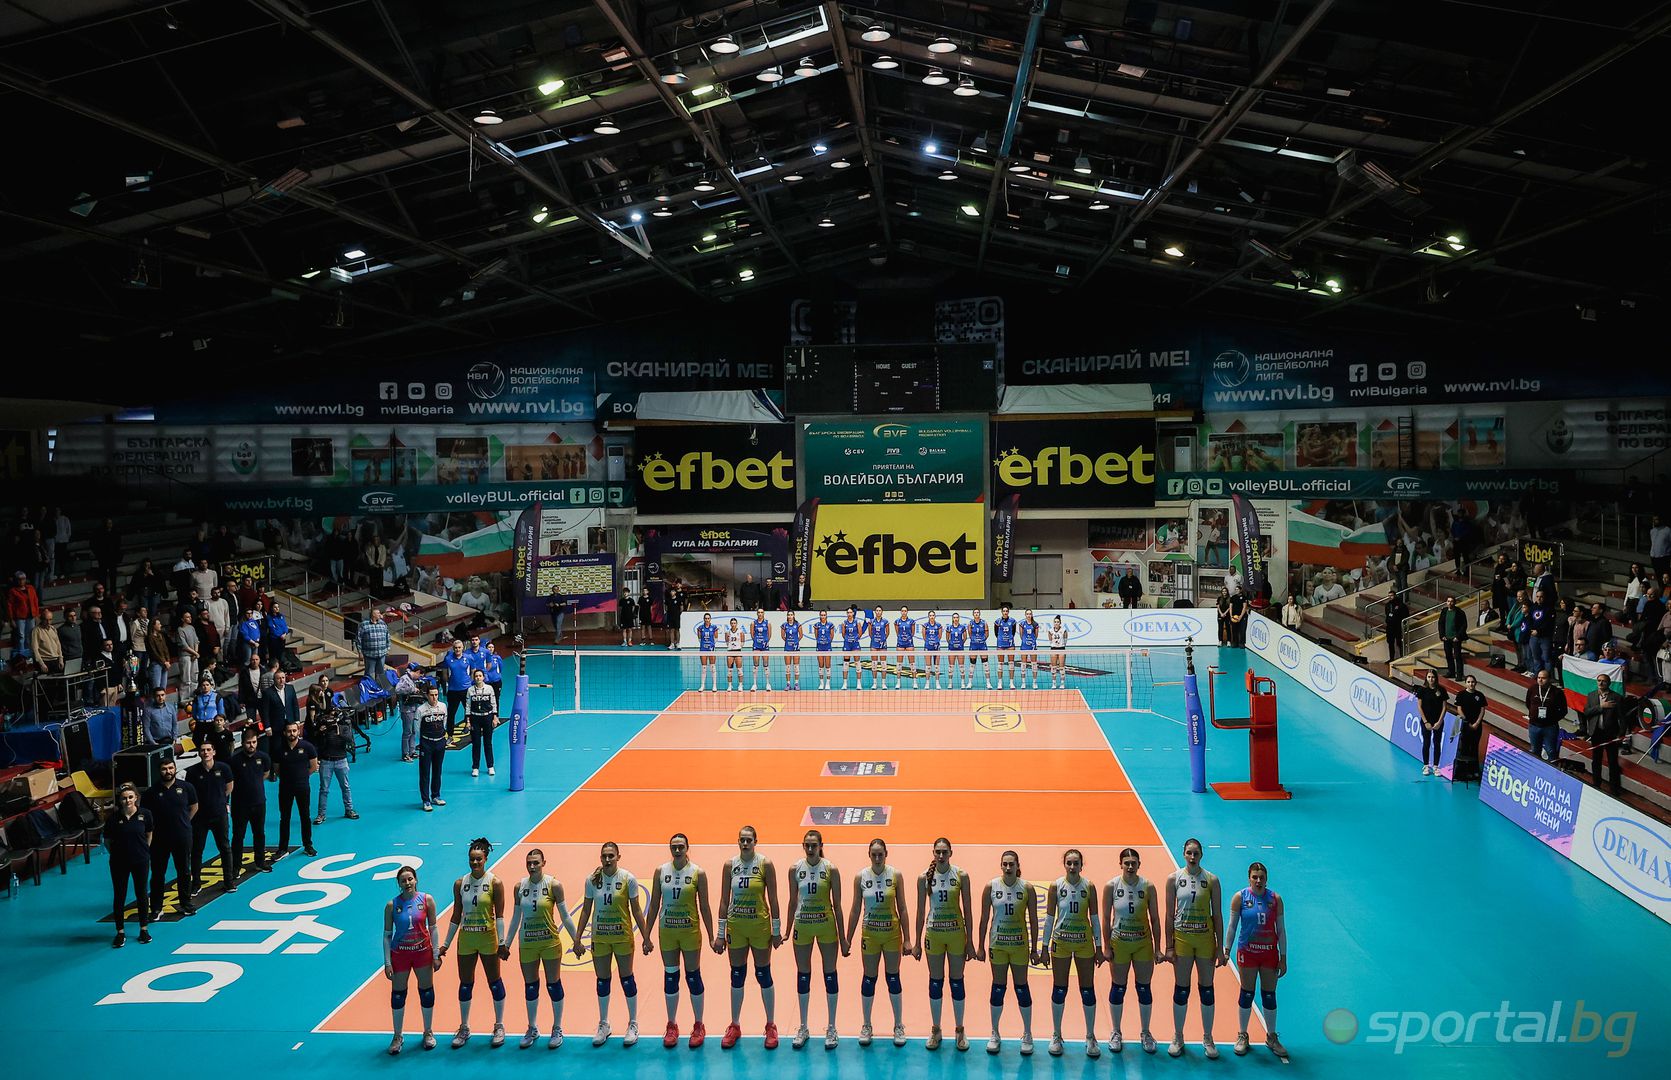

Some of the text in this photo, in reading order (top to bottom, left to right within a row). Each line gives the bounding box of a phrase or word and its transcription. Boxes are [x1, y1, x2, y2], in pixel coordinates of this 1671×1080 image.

[1255, 349, 1333, 362] НАЦИОНАЛНА
[606, 357, 774, 379] СКАНИРАЙ МЕ!
[1022, 350, 1190, 375] СКАНИРАЙ МЕ!
[1255, 358, 1329, 371] ВОЛЕЙБОЛНА
[467, 372, 488, 380] НВЛ
[510, 367, 584, 376] НАЦИОНАЛНА
[1255, 372, 1284, 382] ЛИГА
[510, 375, 580, 385] ВОЛЕЙБОЛНА
[1444, 378, 1541, 394] www.nvl.bg
[511, 386, 539, 395] ЛИГА
[1213, 384, 1334, 402] www.nvl.bg
[1350, 384, 1428, 398] nvlBulgaria
[274, 404, 365, 416] www.nvl.bg
[380, 404, 454, 416] nvlBulgaria
[468, 399, 585, 416] www.nvl.bg
[643, 450, 793, 491] efbet
[999, 445, 1155, 487] efbet
[823, 472, 964, 486] ВОЛЕЙБОЛ БЪЛГАРИЯ
[1228, 478, 1350, 494] volleyBUL.official
[1466, 479, 1559, 495] www.bvf.bg
[446, 489, 565, 505] volleyBUL.official
[225, 498, 313, 512] www.bvf.bg
[701, 530, 732, 540] efbet
[671, 539, 759, 548] КУПА НА БЪЛГАРИЯ
[994, 534, 1004, 566] efbet
[794, 537, 804, 567] efbet
[825, 532, 978, 575] efbet
[1525, 545, 1553, 563] efbet
[515, 545, 526, 578] efbet
[1132, 621, 1193, 633] DEMAX
[1279, 641, 1299, 663] DEMAX
[1311, 660, 1335, 684] DEMAX
[1352, 687, 1383, 714] DEMAX
[1488, 764, 1530, 807] efbet
[1534, 775, 1571, 807] КУПА НА
[1528, 787, 1573, 824] БЪЛГАРИЯ
[1534, 807, 1560, 833] ЖЕНИ
[738, 877, 750, 888] 20
[807, 882, 817, 895] 18
[603, 893, 612, 906] 14
[672, 887, 682, 900] 17
[875, 891, 884, 903] 15
[938, 890, 948, 902] 33
[1191, 891, 1197, 903] 7
[471, 895, 478, 907] 4
[532, 900, 538, 912] 3
[1069, 901, 1079, 914] 10
[1004, 903, 1014, 915] 16
[1129, 902, 1135, 914] 6
[407, 915, 414, 930] 1
[1257, 912, 1267, 925] 13
[526, 929, 550, 938] WINBET
[398, 943, 424, 952] WINBET
[1249, 942, 1275, 951] WINBET
